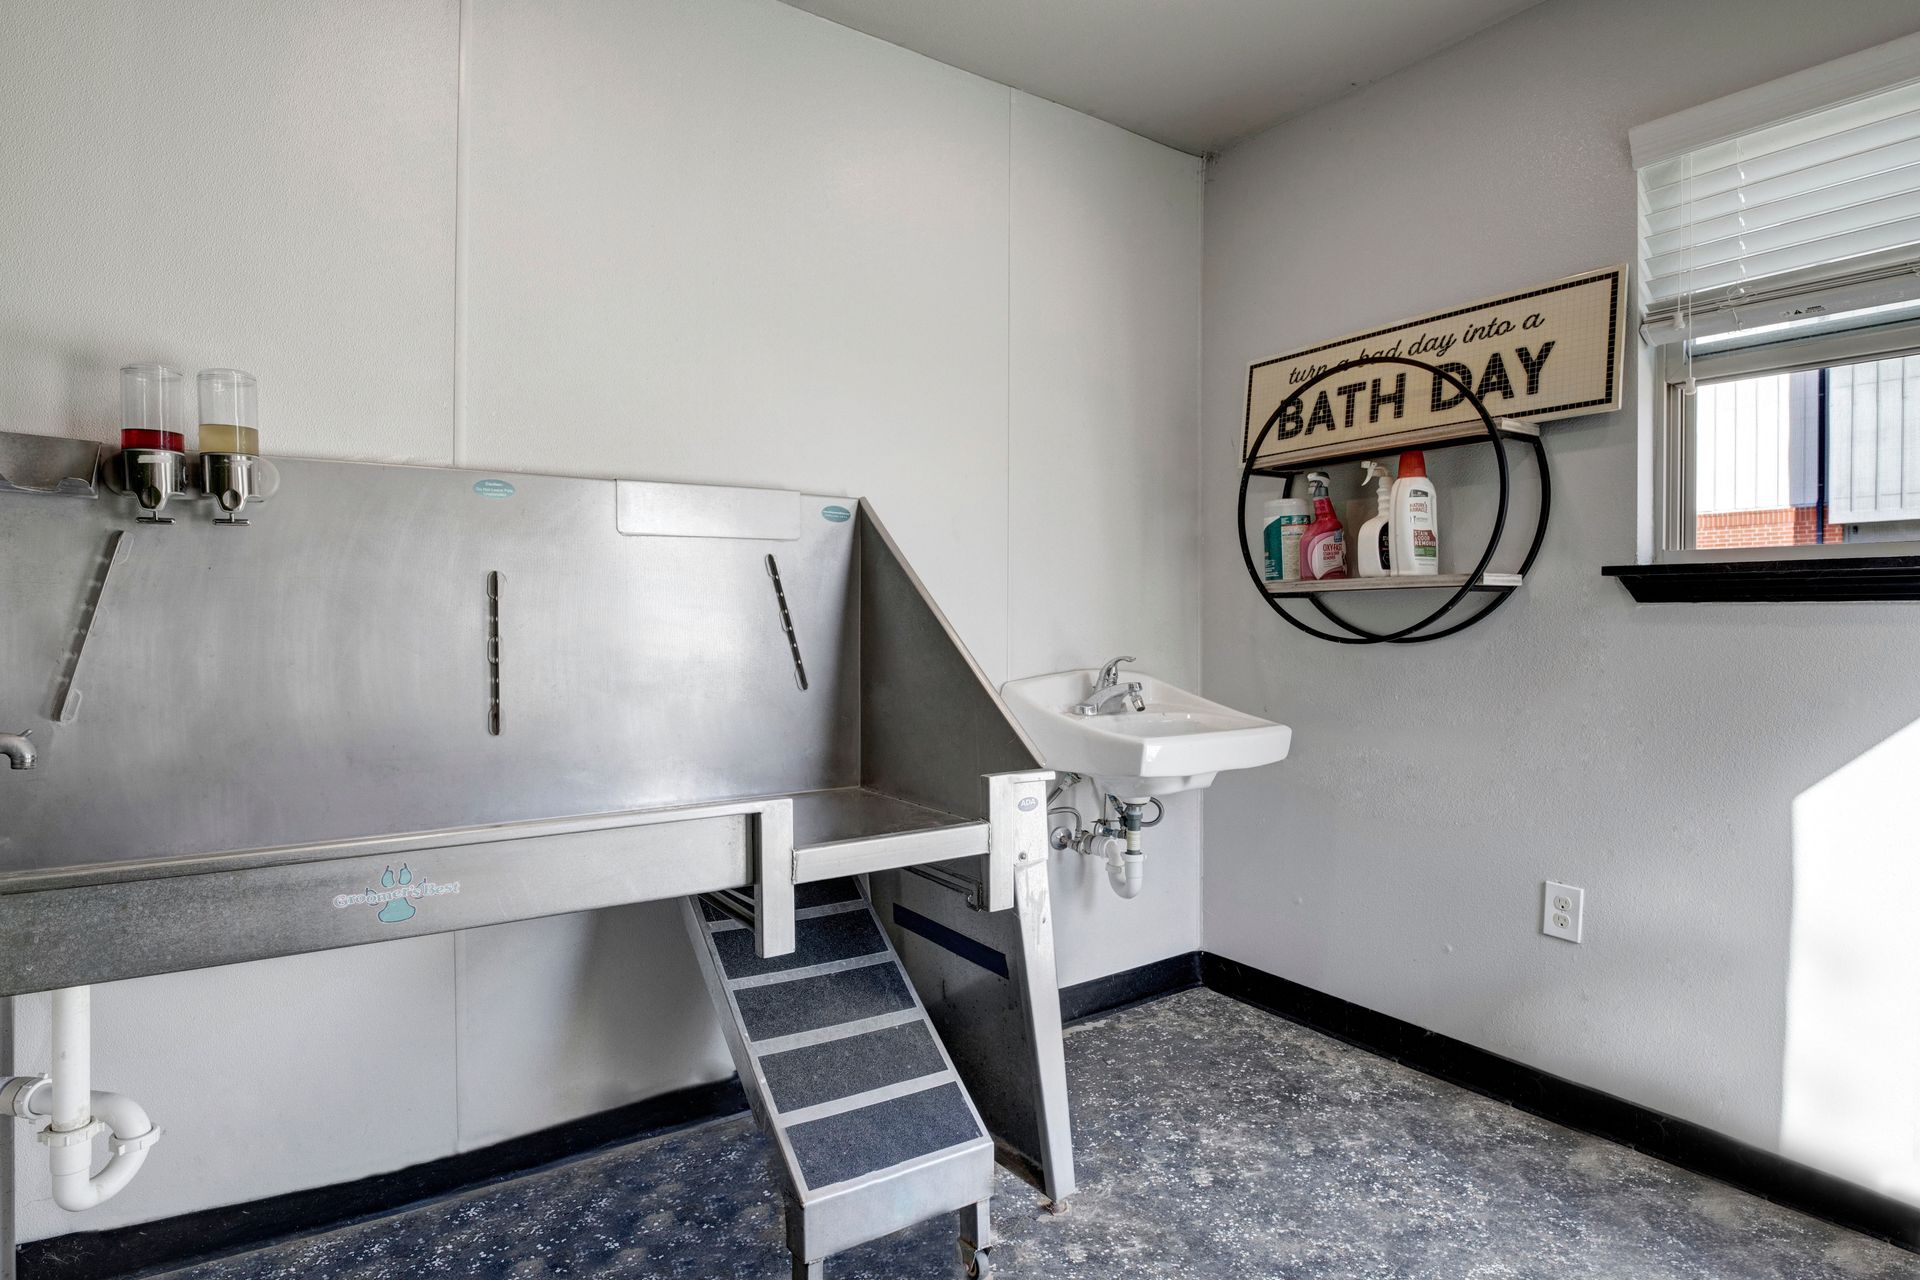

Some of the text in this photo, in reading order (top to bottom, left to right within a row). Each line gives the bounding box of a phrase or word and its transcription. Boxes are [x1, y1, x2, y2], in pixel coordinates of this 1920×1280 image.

[1289, 364, 1328, 385] turn
[1408, 333, 1457, 358] day
[1462, 317, 1516, 344] into
[1522, 312, 1546, 331] a
[1278, 341, 1557, 440] BATH DAY
[1020, 798, 1037, 807] ADA
[333, 881, 461, 909] Groomer's Best
